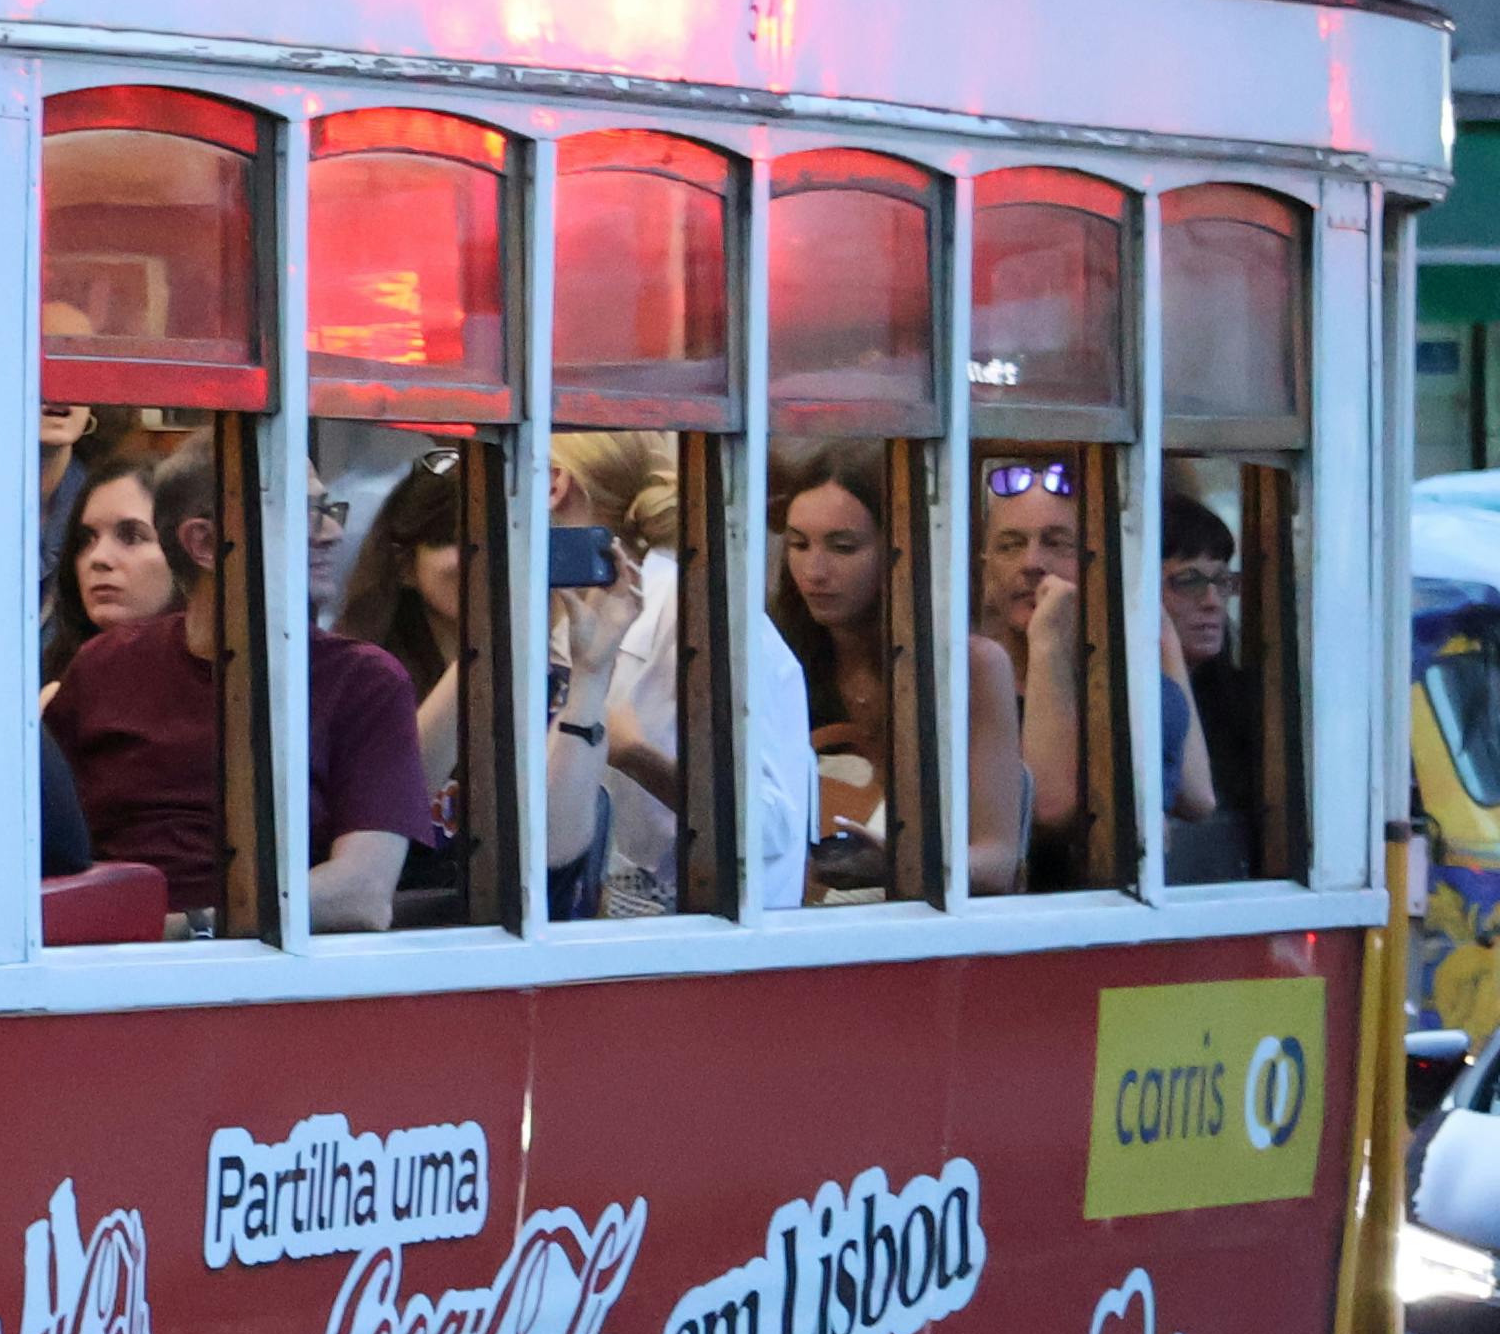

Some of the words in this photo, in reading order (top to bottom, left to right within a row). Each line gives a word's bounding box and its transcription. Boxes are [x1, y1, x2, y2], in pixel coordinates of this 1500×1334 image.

[1115, 1030, 1226, 1146] carris
[215, 1140, 377, 1244] Partilha
[392, 1147, 480, 1219] uma
